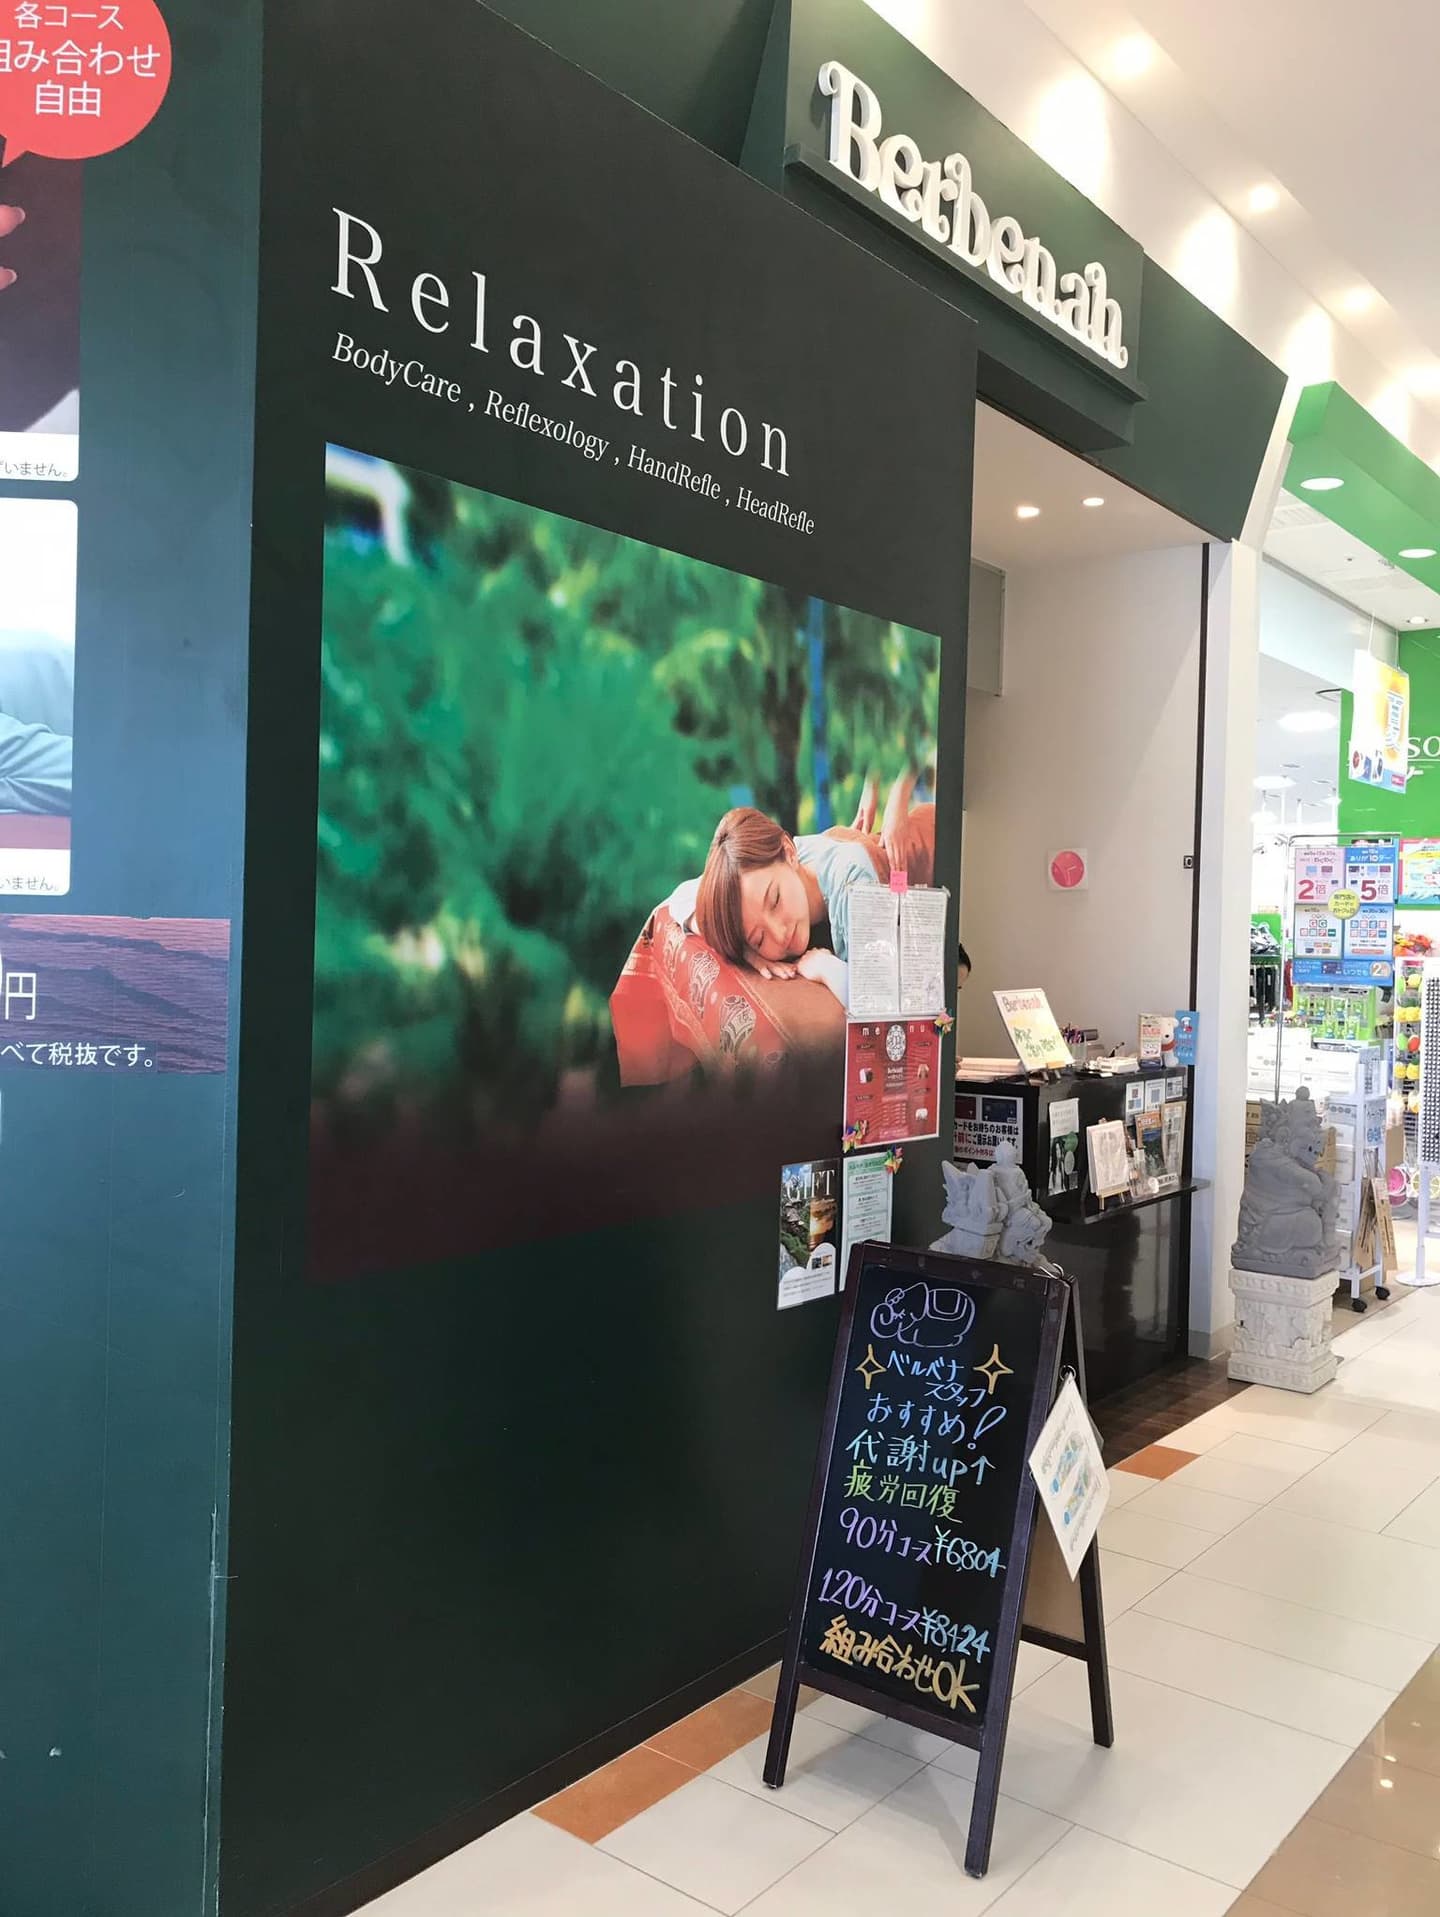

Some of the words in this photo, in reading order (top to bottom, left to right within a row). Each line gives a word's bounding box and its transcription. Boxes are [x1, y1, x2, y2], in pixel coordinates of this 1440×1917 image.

[14, 1, 125, 31] 各コース
[34, 79, 102, 117] 自由
[818, 60, 1128, 369] Berbenah
[331, 207, 789, 477] Relaxation
[332, 332, 462, 403] BodyCare
[484, 389, 610, 462] Reflexology
[627, 444, 722, 501] HandRefle
[736, 486, 816, 536] HeadRefle
[0, 1041, 153, 1068] べて税抜です。
[786, 1169, 835, 1202] GIFT
[887, 1350, 965, 1382] ベルベナ
[924, 1382, 987, 1408] スタッフ
[843, 1459, 963, 1524] 疲労回復
